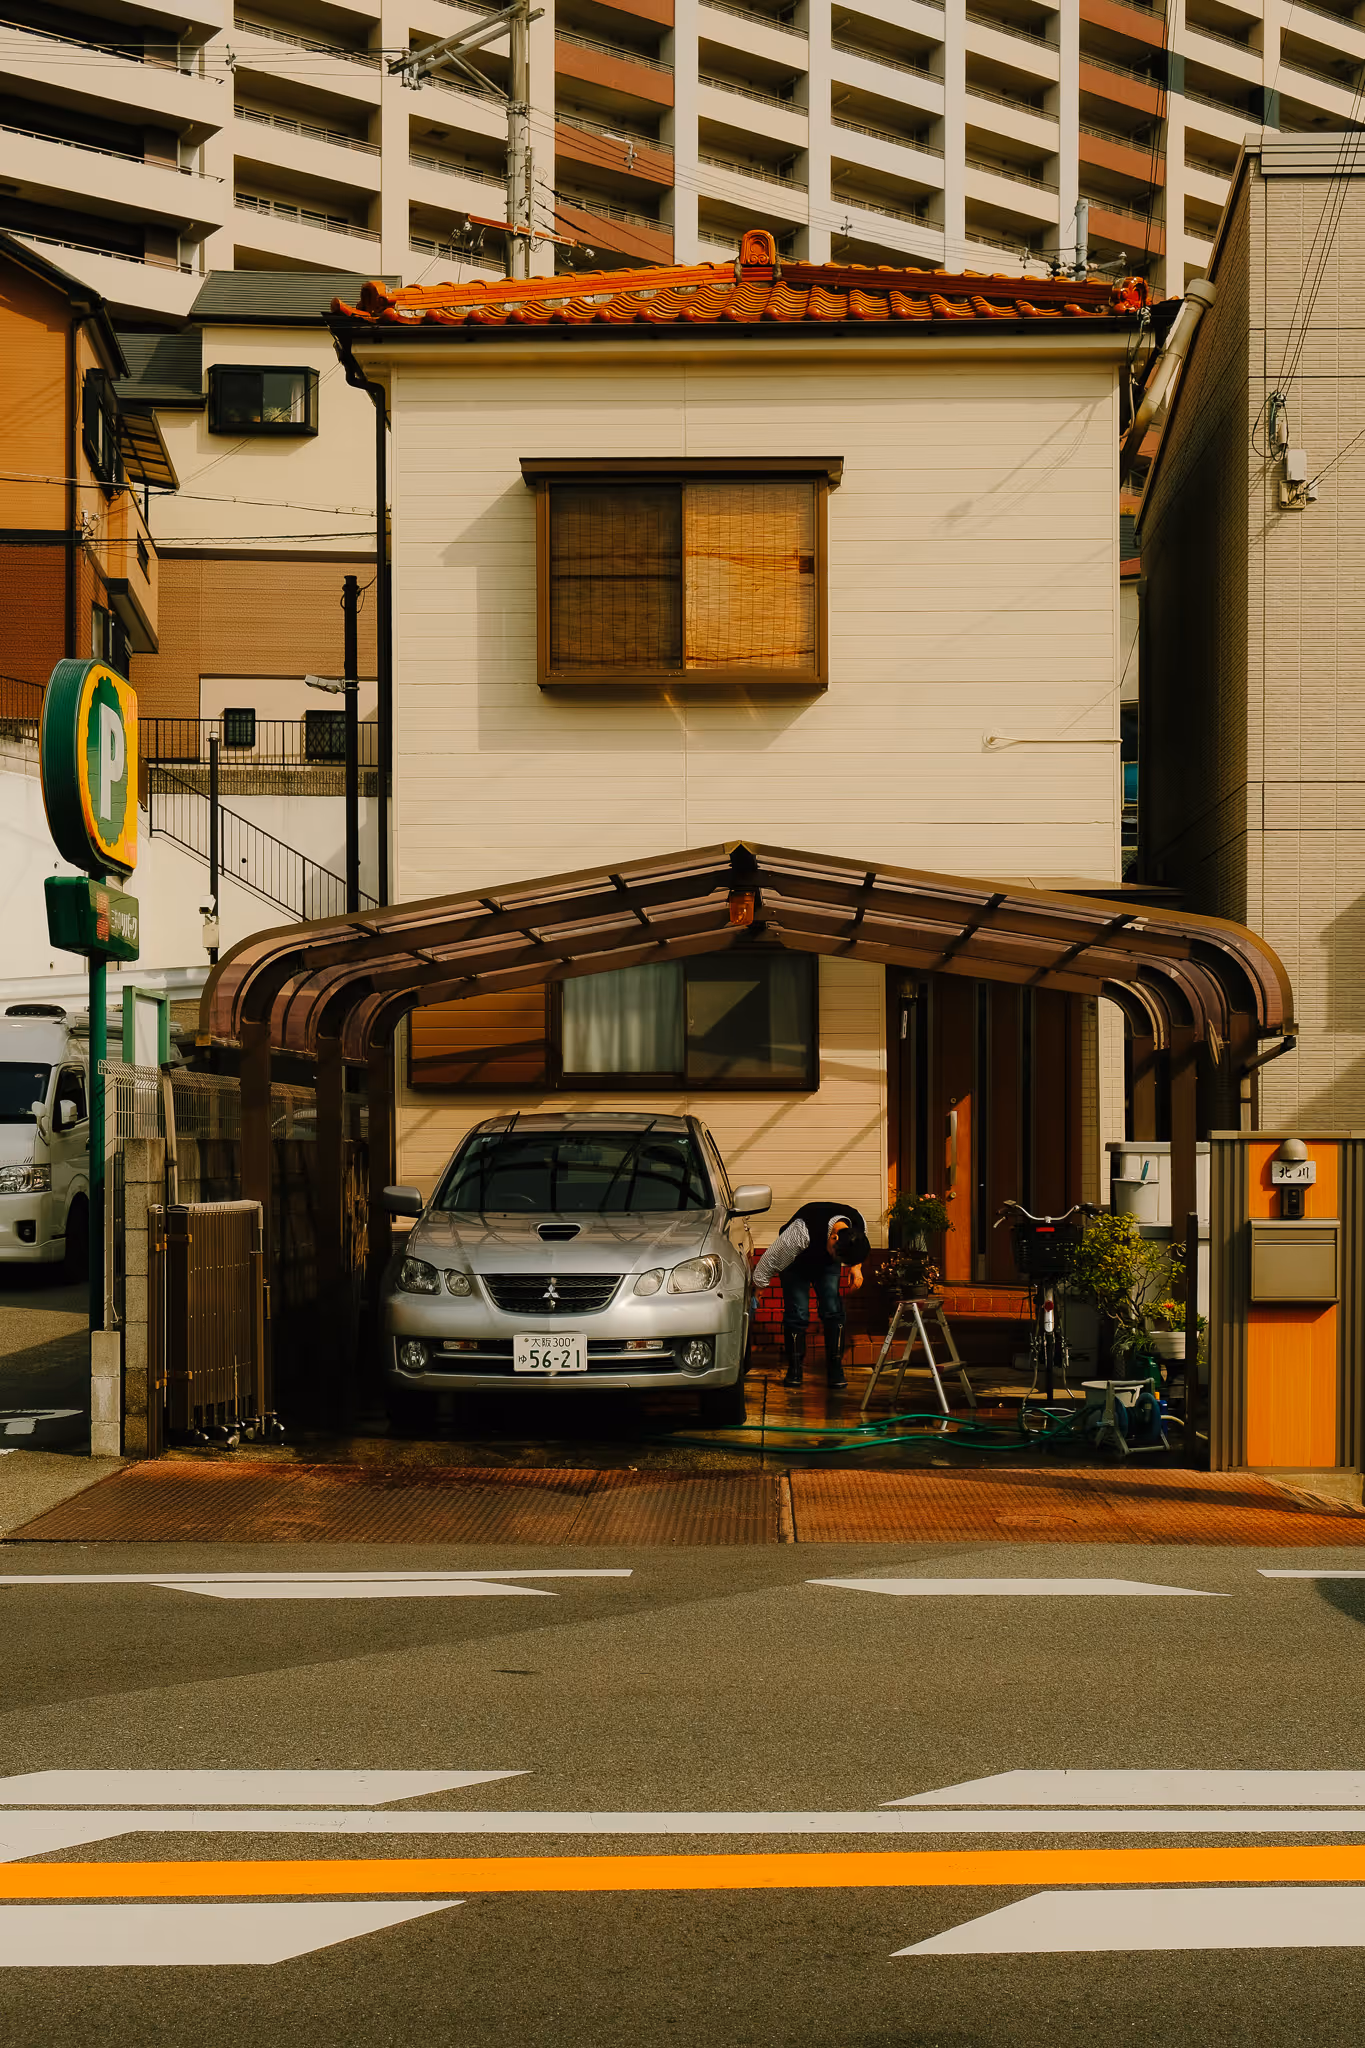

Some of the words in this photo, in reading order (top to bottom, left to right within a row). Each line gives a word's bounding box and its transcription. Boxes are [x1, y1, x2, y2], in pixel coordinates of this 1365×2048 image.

[99, 702, 124, 821] P
[1279, 1166, 1310, 1179] 北川
[530, 1350, 580, 1368] 56-21
